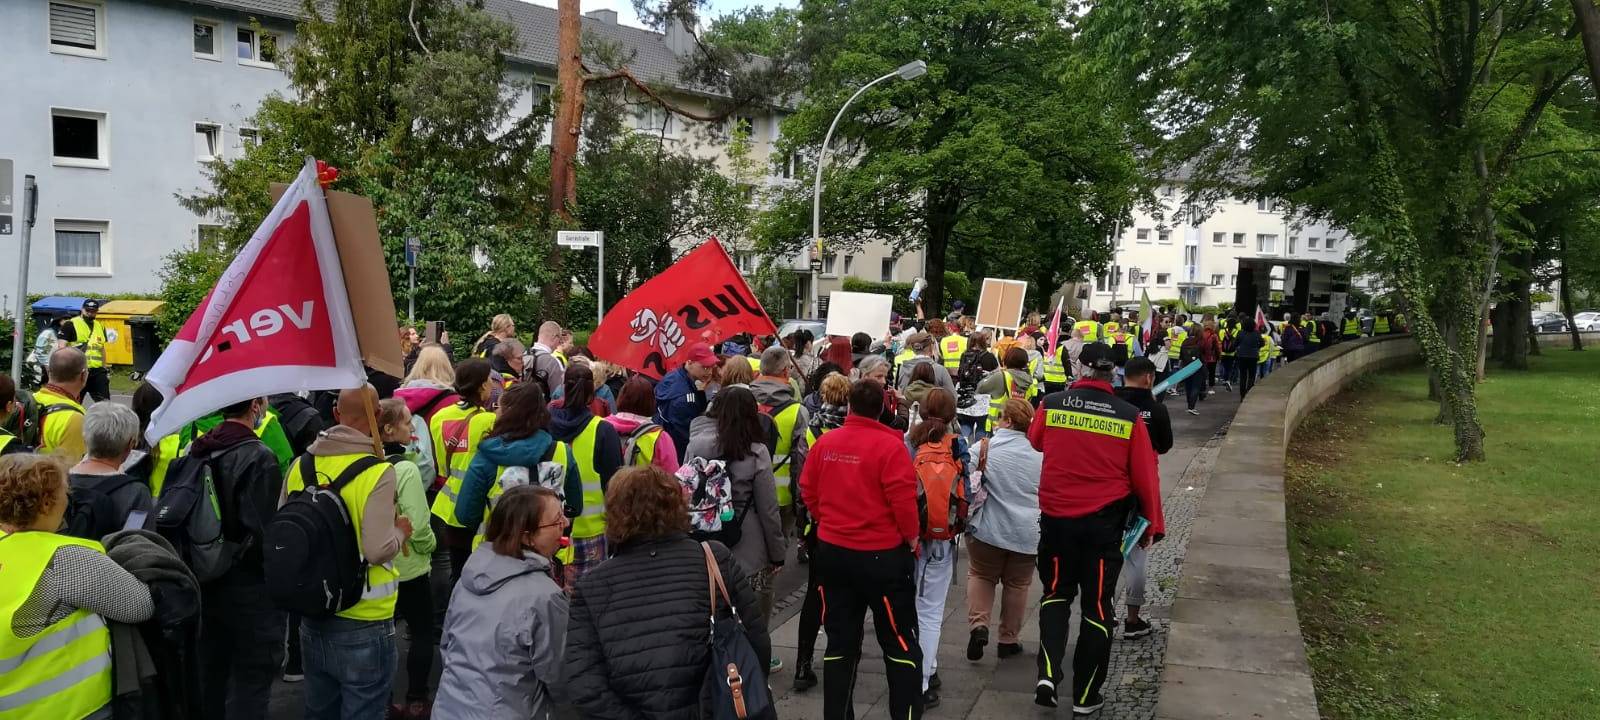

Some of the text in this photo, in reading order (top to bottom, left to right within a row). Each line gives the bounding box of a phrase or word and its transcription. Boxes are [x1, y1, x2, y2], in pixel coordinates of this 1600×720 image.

[1062, 395, 1083, 409] ukb
[1051, 412, 1125, 435] UKB BLUTLOGISTIK
